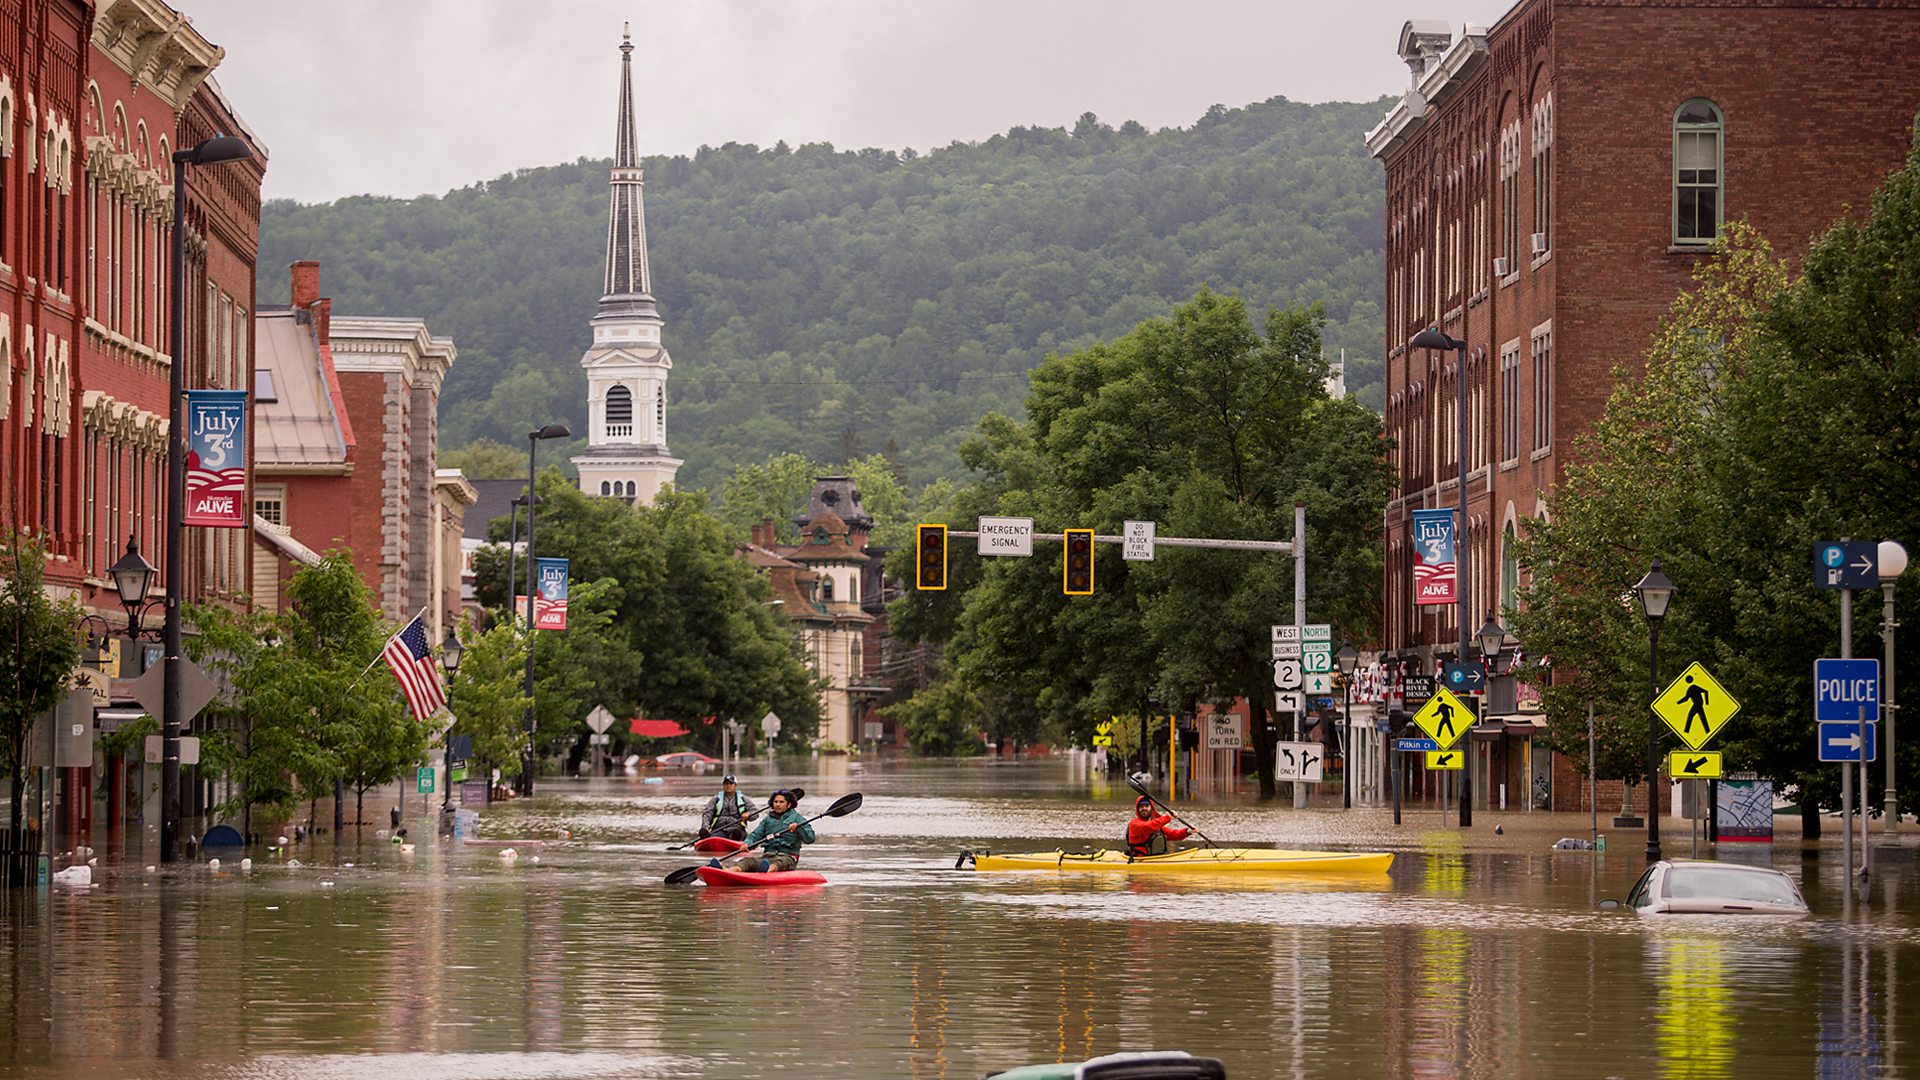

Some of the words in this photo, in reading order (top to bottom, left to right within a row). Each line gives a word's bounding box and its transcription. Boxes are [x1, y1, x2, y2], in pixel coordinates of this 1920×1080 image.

[194, 410, 240, 438] July
[203, 433, 233, 467] 3rd
[195, 500, 233, 513] ALIVE
[982, 525, 1030, 535] EMERGENCY
[1418, 523, 1449, 542] July
[991, 537, 1019, 547] SIGNAL
[1425, 539, 1446, 562] 3rd
[540, 569, 565, 584] July
[1422, 586, 1448, 596] ALIVE
[540, 615, 561, 624] ALIVE
[1276, 628, 1297, 638] WEST
[1303, 627, 1329, 637] NORTH
[1275, 647, 1299, 655] BUSINESS
[1308, 653, 1326, 670] 12
[1282, 666, 1293, 682] 2
[1819, 679, 1876, 702] POLICE
[1215, 727, 1235, 735] TURN
[1209, 738, 1221, 746] ON
[1399, 740, 1420, 748] Pitkin
